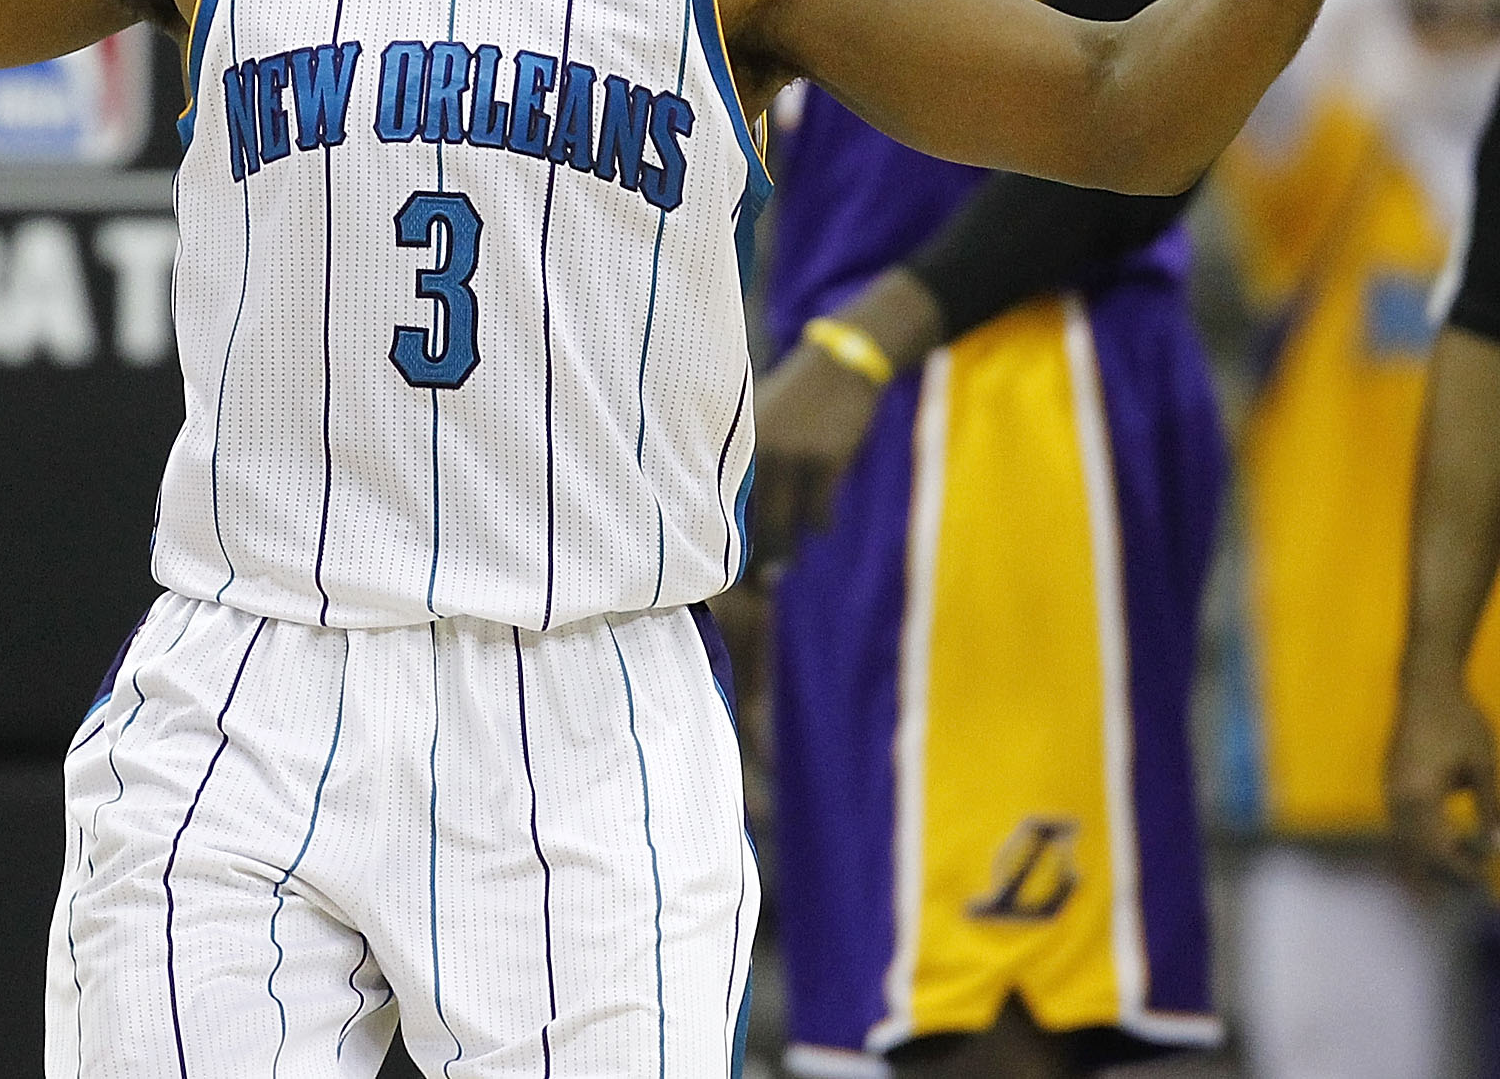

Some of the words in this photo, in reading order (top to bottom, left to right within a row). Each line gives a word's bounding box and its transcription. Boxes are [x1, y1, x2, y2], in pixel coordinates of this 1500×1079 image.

[223, 40, 362, 183] NEW
[373, 40, 695, 213] ORLEANS
[94, 219, 181, 366] T
[388, 190, 484, 390] 3
